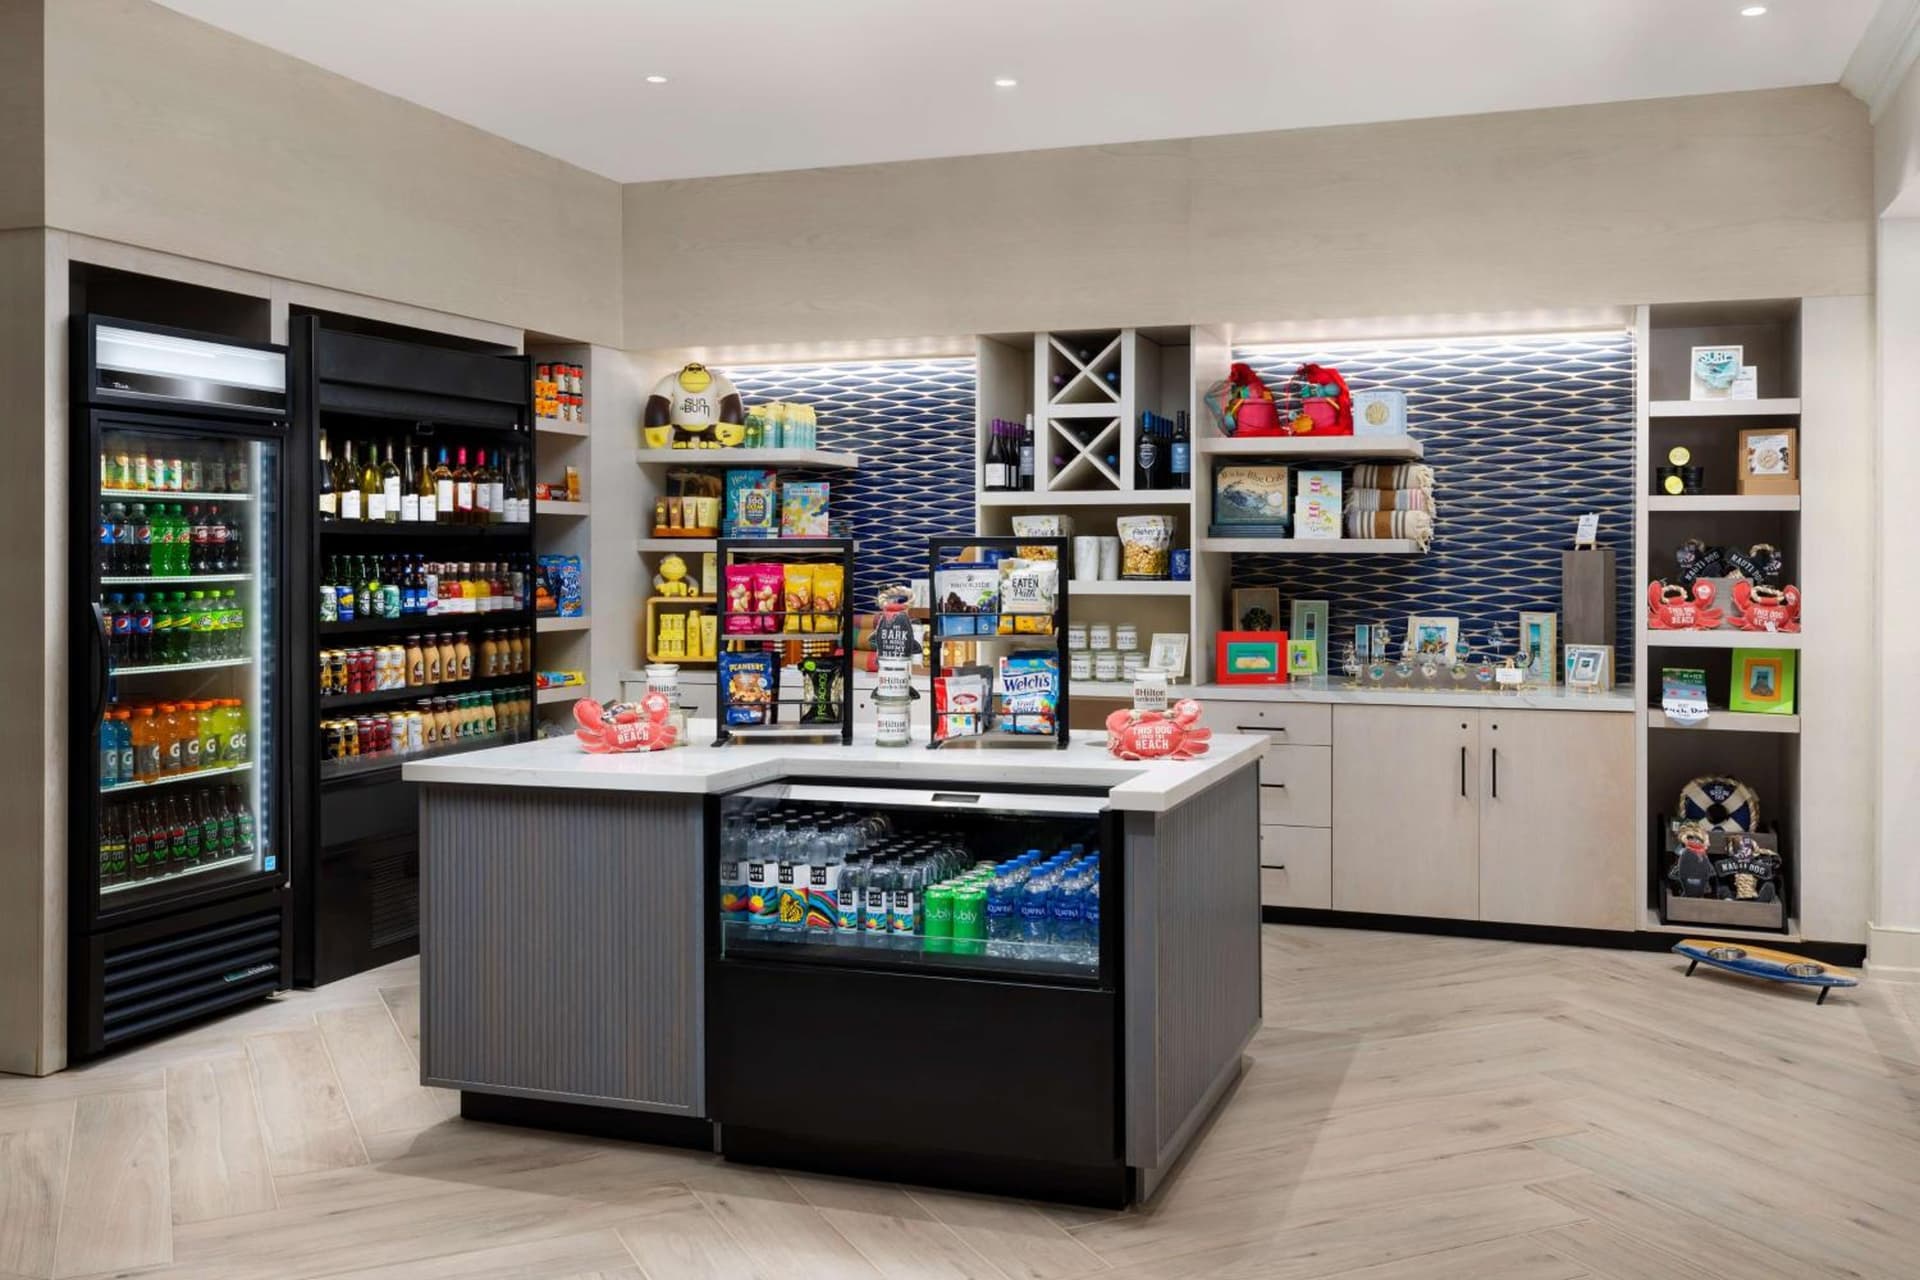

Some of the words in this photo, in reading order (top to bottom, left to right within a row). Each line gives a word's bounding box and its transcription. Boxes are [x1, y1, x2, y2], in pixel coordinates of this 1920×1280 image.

[1012, 578, 1038, 588] EATEN
[881, 629, 908, 641] BARK
[728, 662, 764, 671] PLANTERS
[1003, 673, 1050, 692] Welch's
[188, 740, 199, 754] G
[206, 738, 216, 752] G
[230, 734, 240, 749] G
[1136, 739, 1169, 750] BEACH
[170, 743, 180, 757] G
[108, 751, 118, 766] G
[123, 751, 133, 764] G
